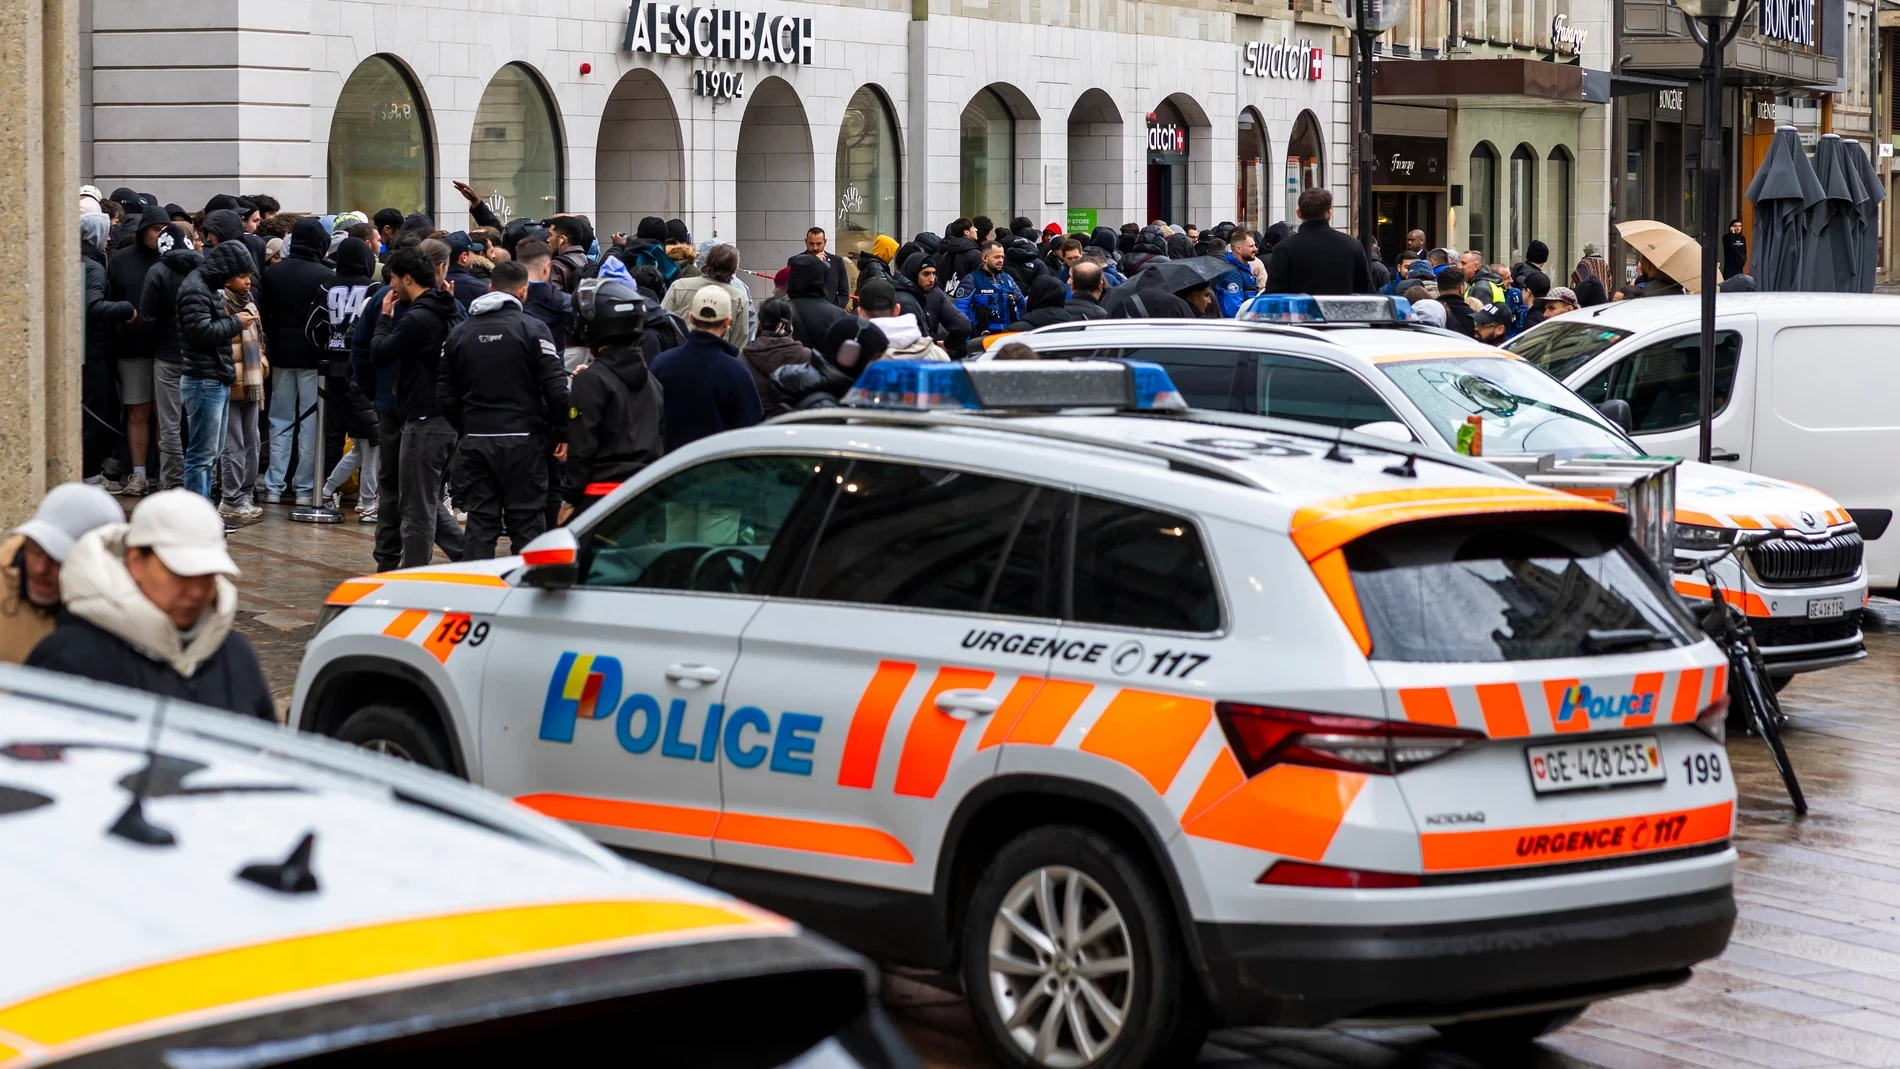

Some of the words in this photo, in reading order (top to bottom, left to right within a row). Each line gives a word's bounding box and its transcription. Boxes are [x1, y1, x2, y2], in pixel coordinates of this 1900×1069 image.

[624, 0, 815, 65] AESCHBACH
[1243, 37, 1313, 80] swatch
[695, 70, 744, 98] 1904
[1147, 123, 1176, 150] atch
[327, 285, 369, 325] 94
[436, 619, 491, 648] 199
[960, 629, 1108, 664] URGENCE
[1147, 649, 1211, 679] 117
[538, 651, 824, 776] POLICE
[1557, 685, 1654, 721] POLICE
[1681, 753, 1722, 785] 199
[1515, 826, 1626, 857] URGENCE
[1653, 815, 1688, 844] 117
